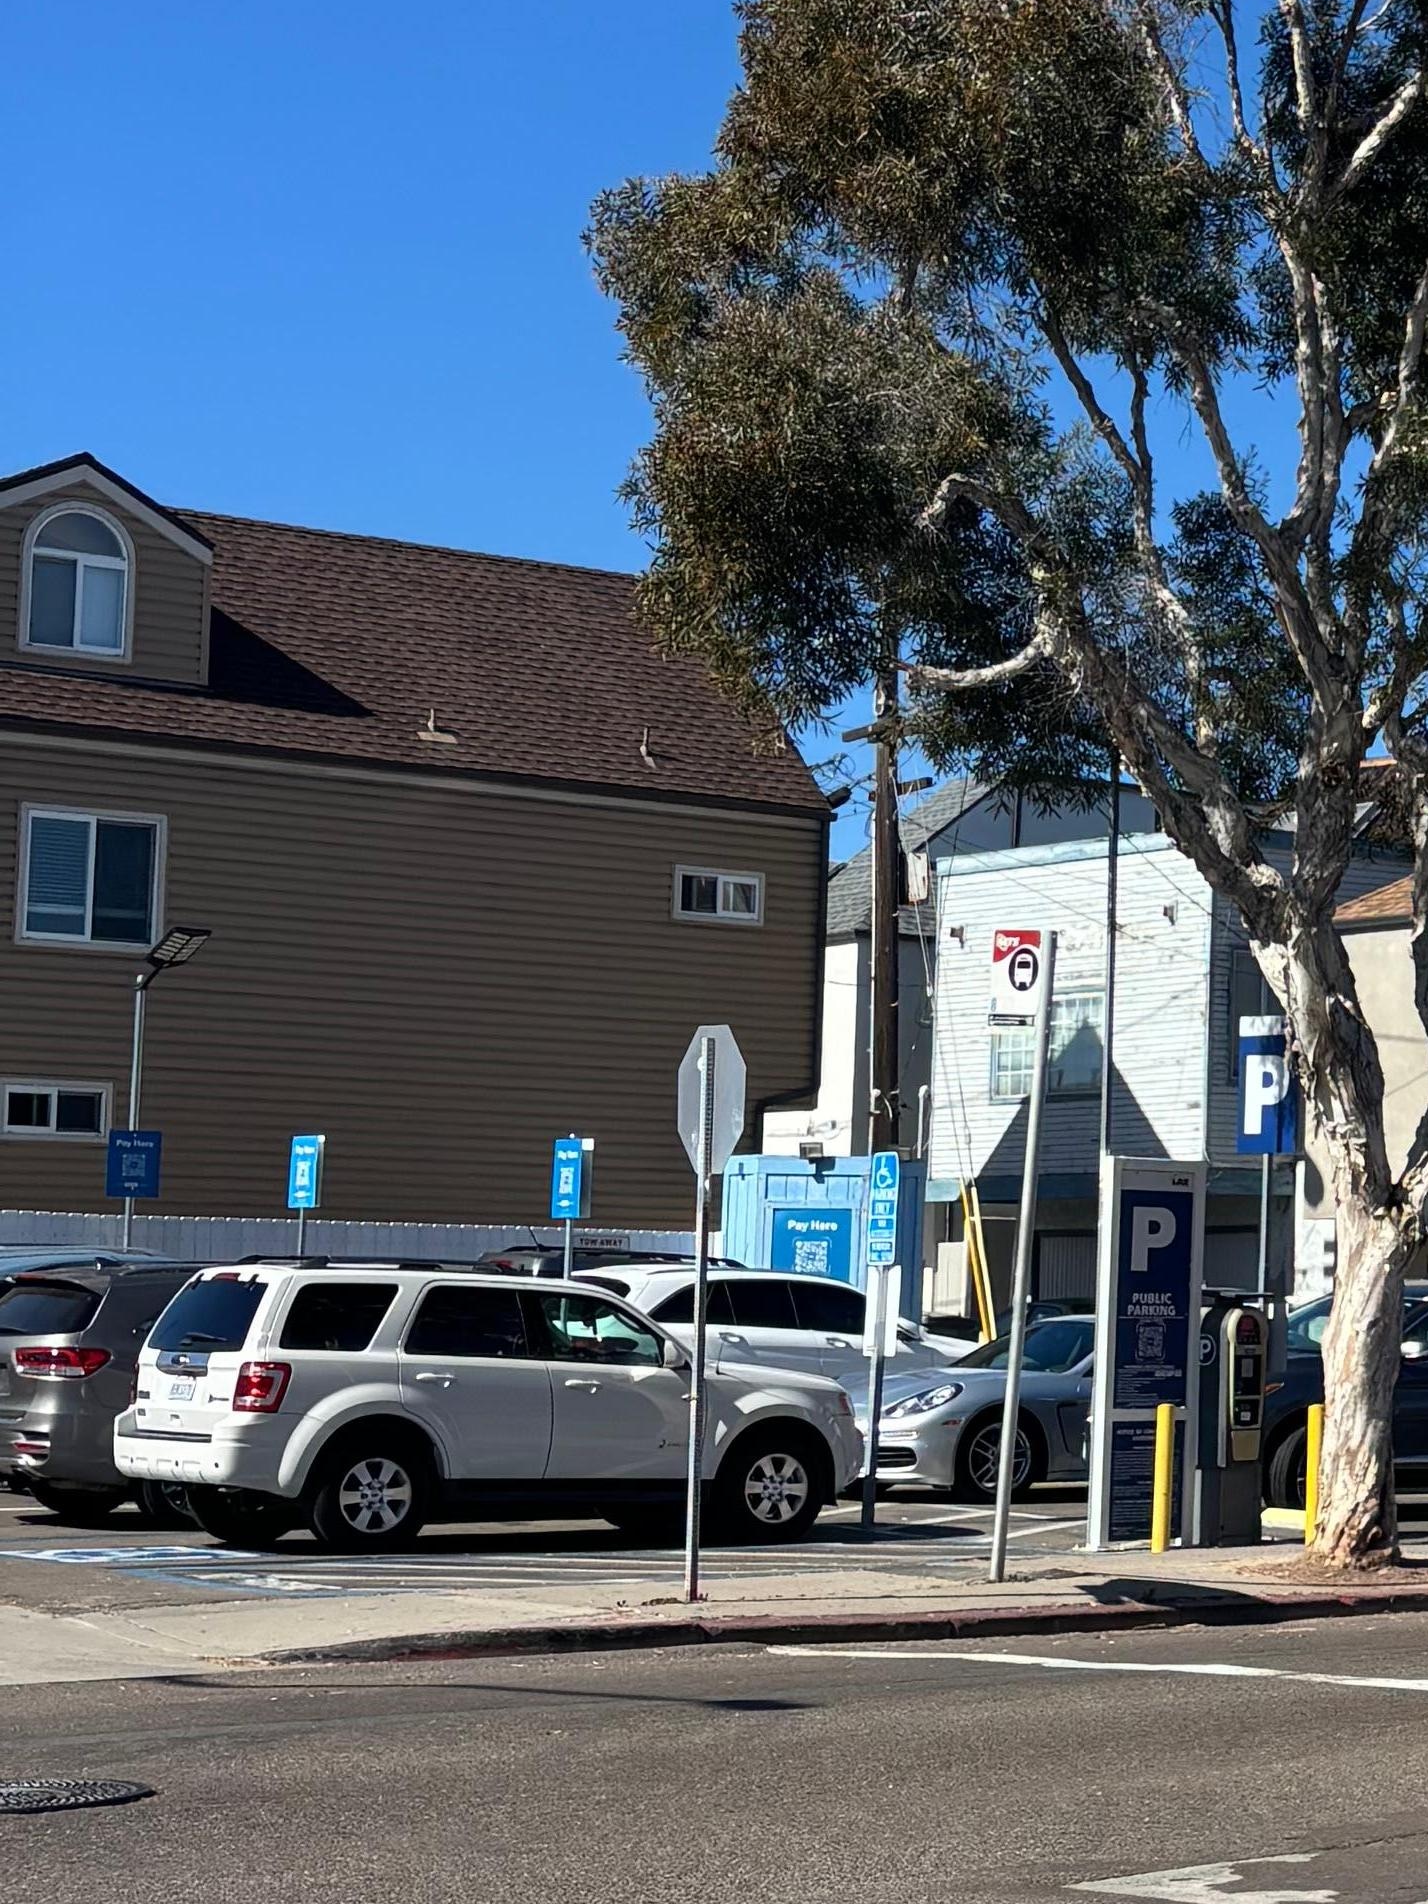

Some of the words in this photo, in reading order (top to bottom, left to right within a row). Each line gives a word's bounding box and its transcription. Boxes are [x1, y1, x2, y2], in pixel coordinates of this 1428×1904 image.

[1243, 1054, 1290, 1135] P
[787, 1219, 809, 1233] Pay
[811, 1219, 838, 1231] Here
[1131, 1206, 1176, 1271] P
[1132, 1292, 1173, 1305] PUBLIC
[1126, 1304, 1177, 1316] PARKING
